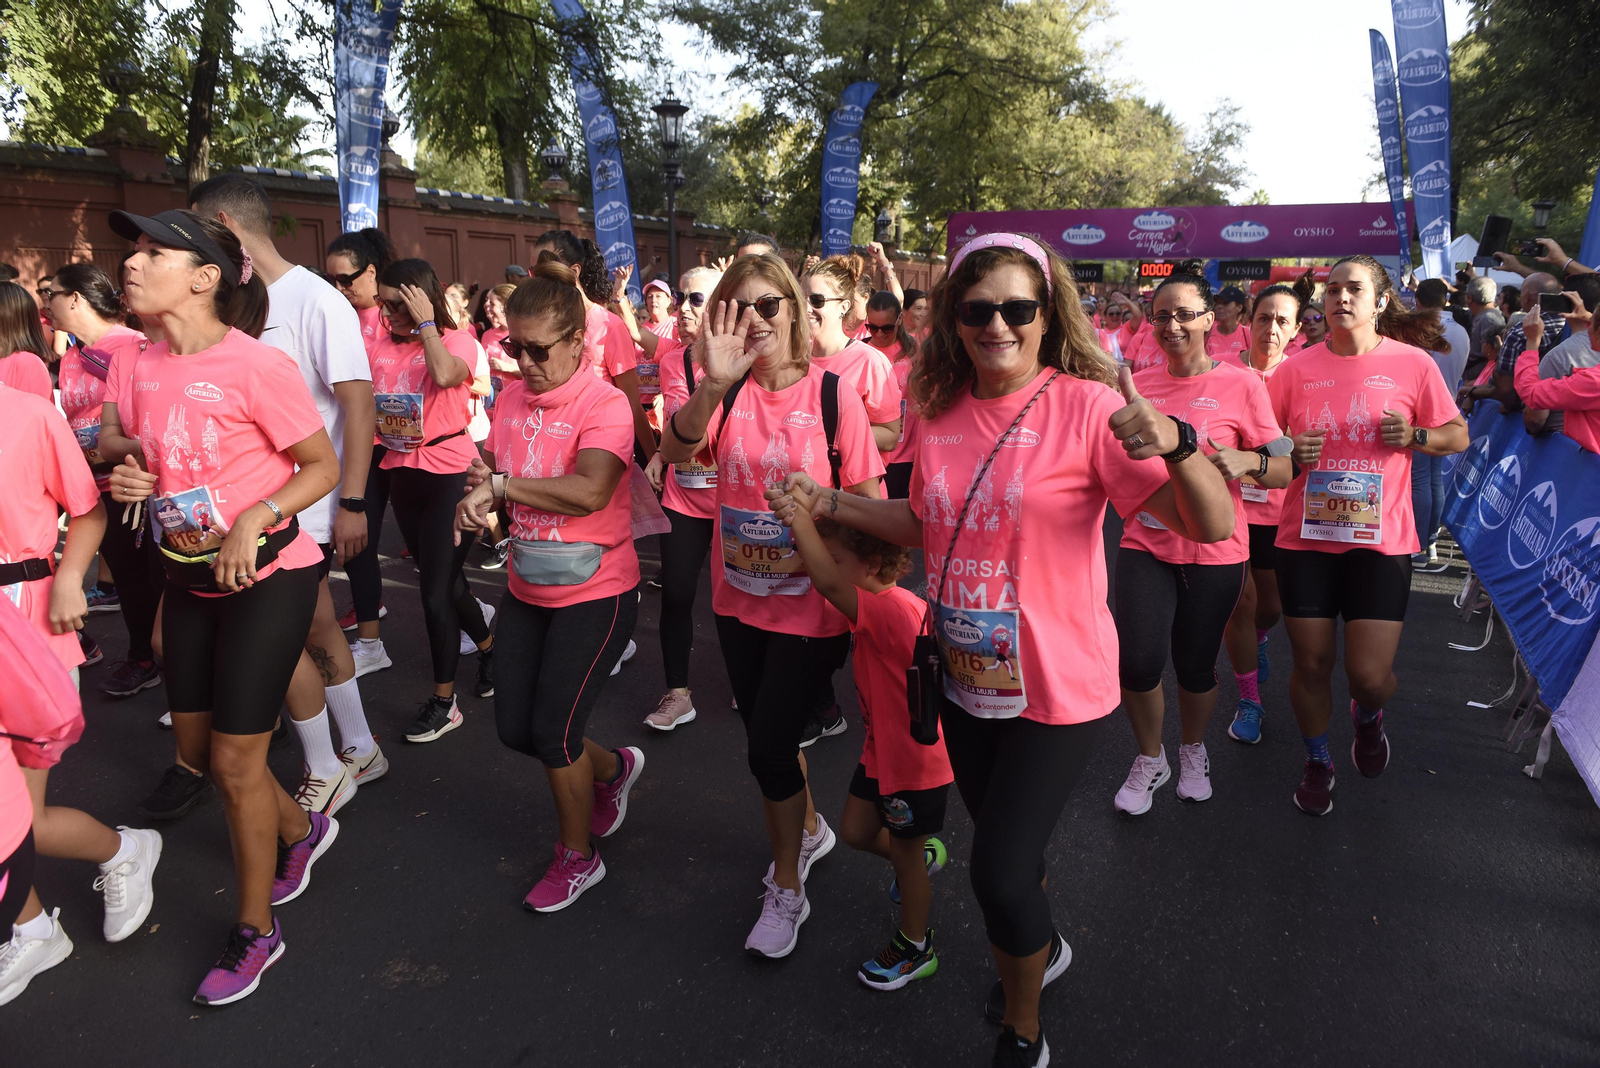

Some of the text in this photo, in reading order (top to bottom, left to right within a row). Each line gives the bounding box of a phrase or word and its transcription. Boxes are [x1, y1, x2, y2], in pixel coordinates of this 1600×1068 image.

[1136, 218, 1173, 226] ASTURIANA
[1065, 231, 1103, 240] ASTURIANA
[1128, 229, 1164, 241] Carrera
[1224, 230, 1267, 239] ASTURIANA
[1294, 227, 1335, 237] OYSHO
[1147, 239, 1176, 256] Mujer
[1071, 269, 1097, 279] YSHO
[1226, 266, 1264, 276] OYSHO
[135, 382, 159, 391] OYSHO
[1303, 379, 1335, 391] OYSHO
[187, 387, 221, 399] ASTURIANA
[731, 407, 754, 420] SHO
[385, 415, 407, 428] 016
[547, 426, 572, 436] ASTURIAN
[925, 434, 963, 446] OYSHO
[1004, 436, 1037, 445] STURIANA
[84, 447, 97, 459] 16
[1326, 459, 1385, 471] DORSAL
[1481, 472, 1512, 519] ASTURIANA
[1327, 498, 1360, 513] 016
[517, 511, 568, 527] ORSAL
[742, 525, 780, 536] ASTURIANA
[1309, 529, 1333, 537] OYSHO
[1512, 502, 1547, 559] ASTURIANA
[167, 530, 198, 549] 016
[742, 543, 780, 561] 016
[736, 567, 755, 577] CARRERA
[751, 563, 771, 571] 5274
[941, 555, 1020, 580] DORSAL
[730, 573, 751, 588] OYSHO
[775, 582, 803, 590] Santander
[927, 572, 1018, 610] SUMA
[945, 624, 981, 640] ASTURIANA
[949, 646, 983, 672] 016
[958, 672, 976, 685] 5276
[976, 688, 998, 696] MUJER
[982, 703, 1017, 711] Santander
